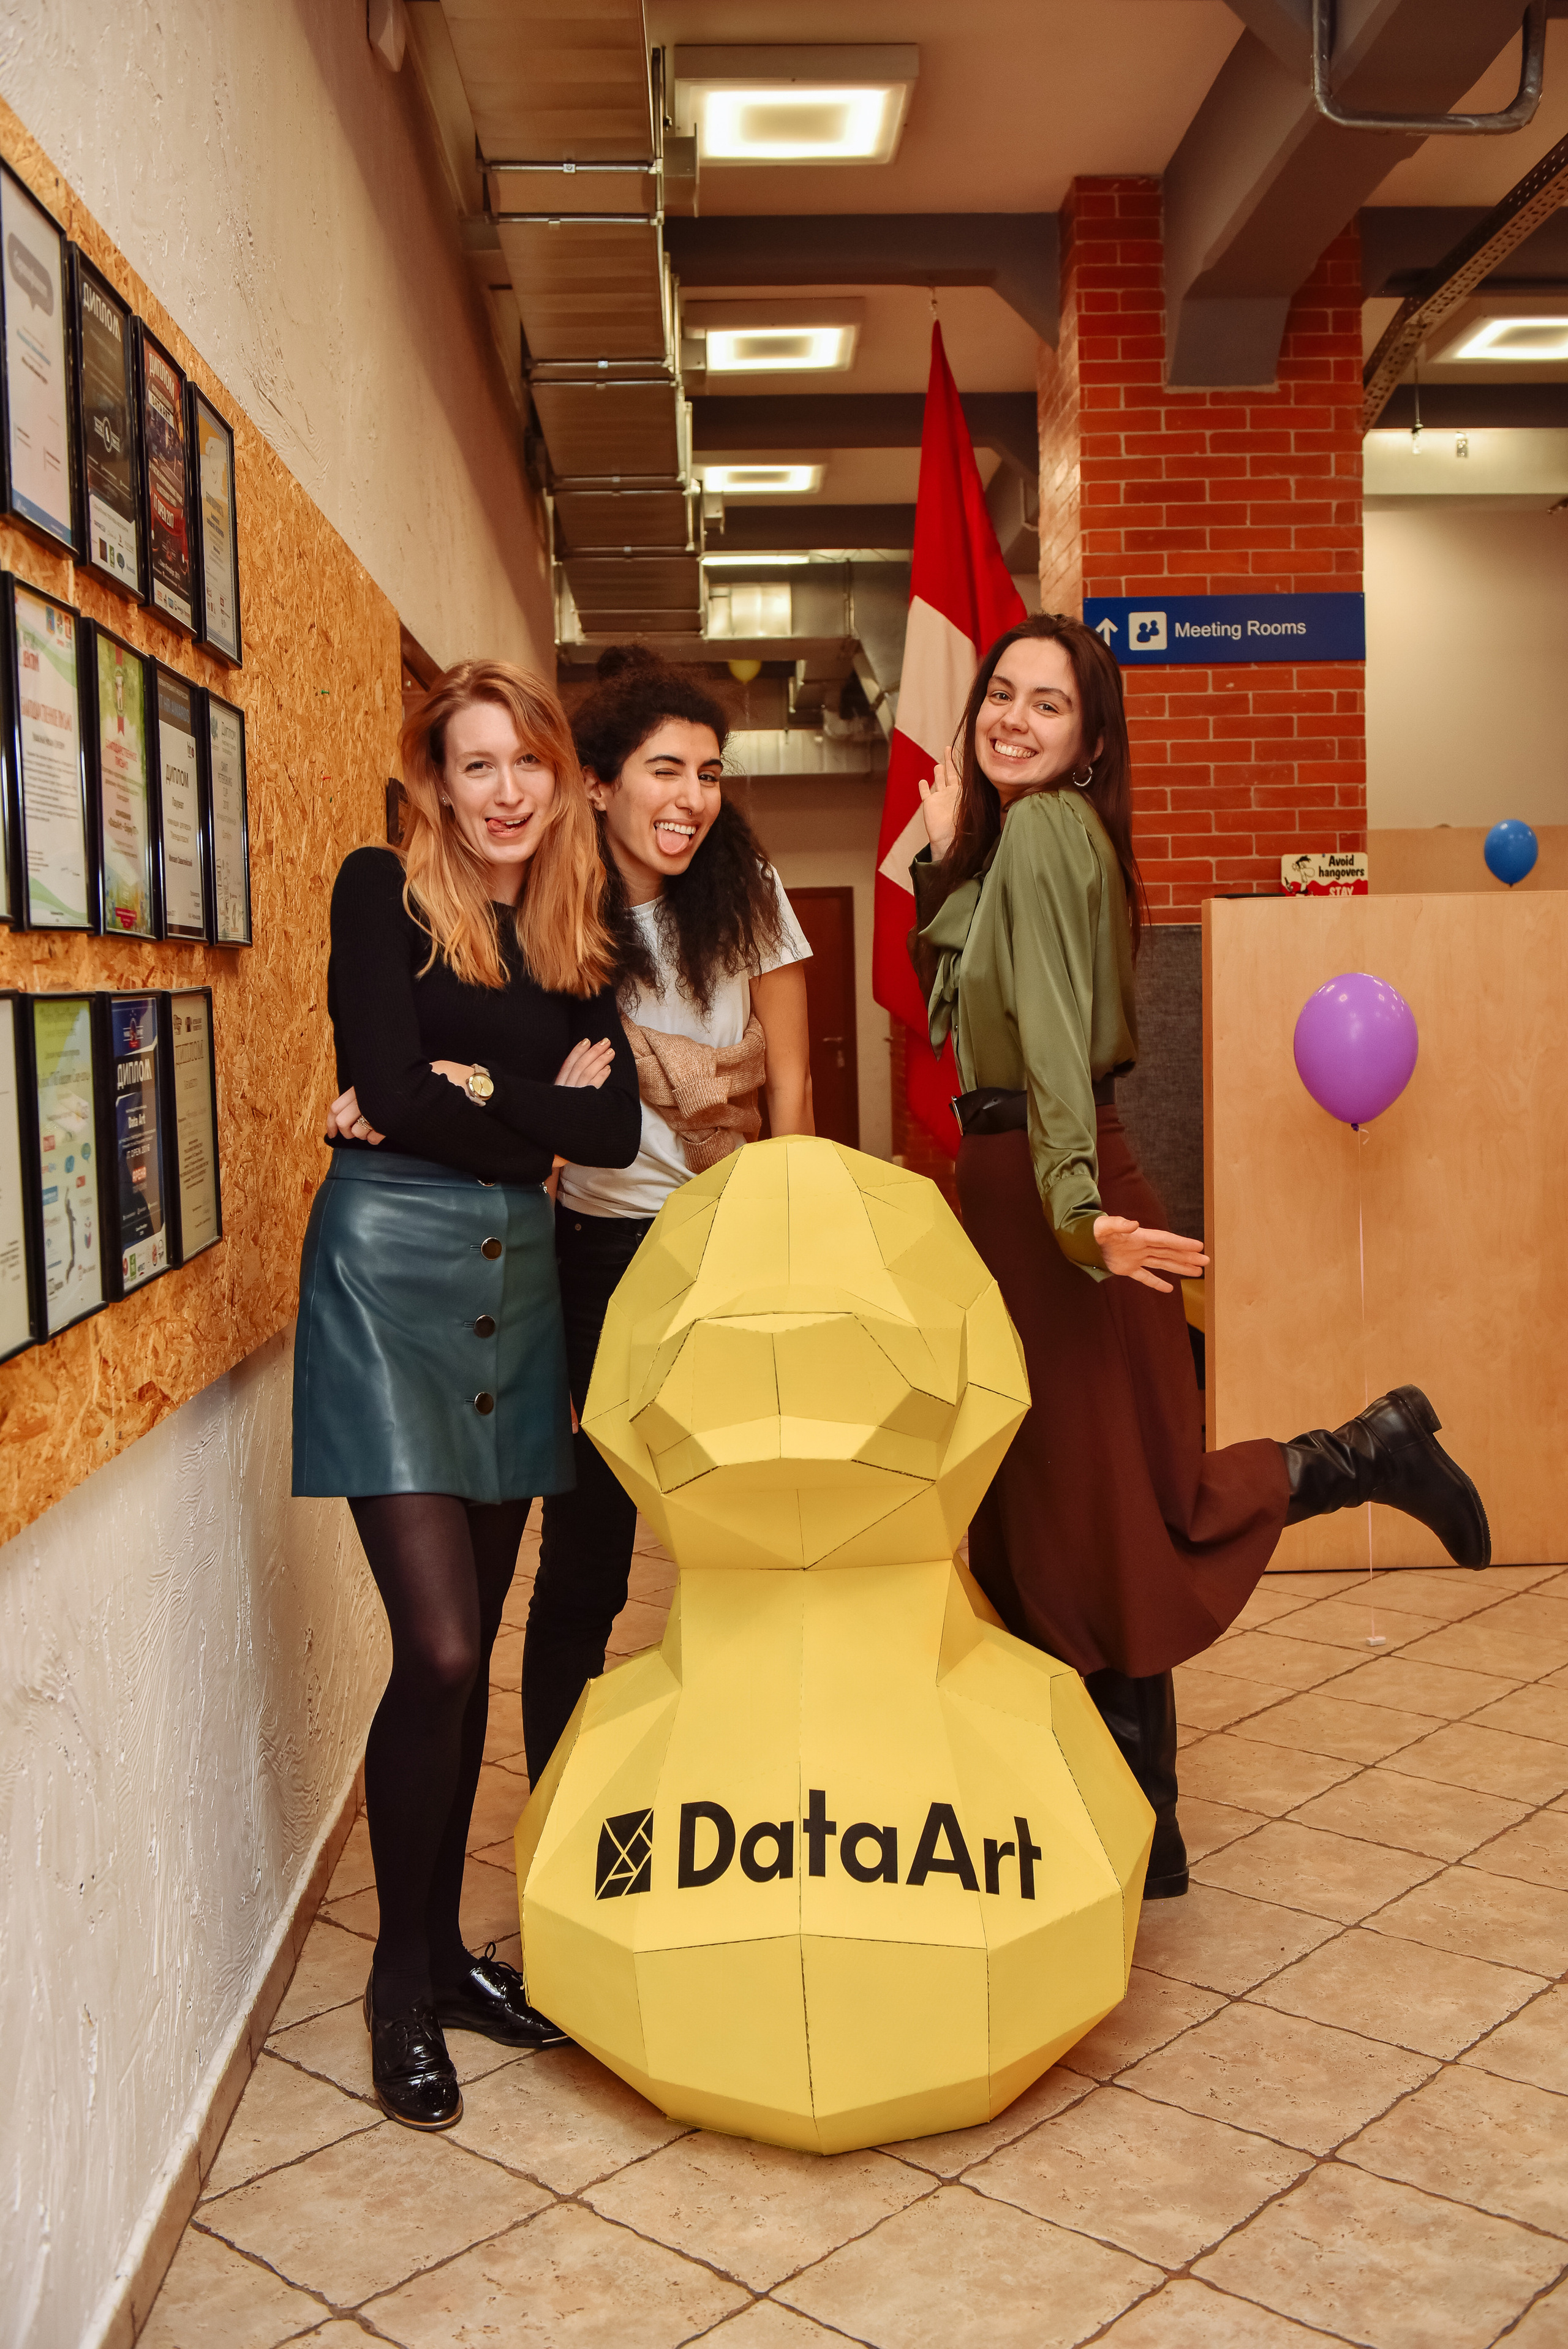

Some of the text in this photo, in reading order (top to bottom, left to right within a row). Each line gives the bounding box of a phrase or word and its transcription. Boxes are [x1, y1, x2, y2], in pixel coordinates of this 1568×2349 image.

[83, 282, 121, 342] ДИПЛОМ
[149, 353, 175, 401] ДИПЛОМ
[1175, 620, 1307, 640] Meeting Rooms
[166, 764, 189, 788] ДИПЛОМ
[1329, 854, 1354, 867] Avoid
[1319, 866, 1365, 880] hangovers
[1329, 886, 1354, 896] STAY
[175, 1040, 204, 1070] ДИПЛОМ
[117, 1058, 153, 1090] ДИПЛОМ
[128, 1116, 138, 1129] Data
[130, 1147, 141, 1158] OPEN
[678, 1789, 1042, 1901] DataArt
